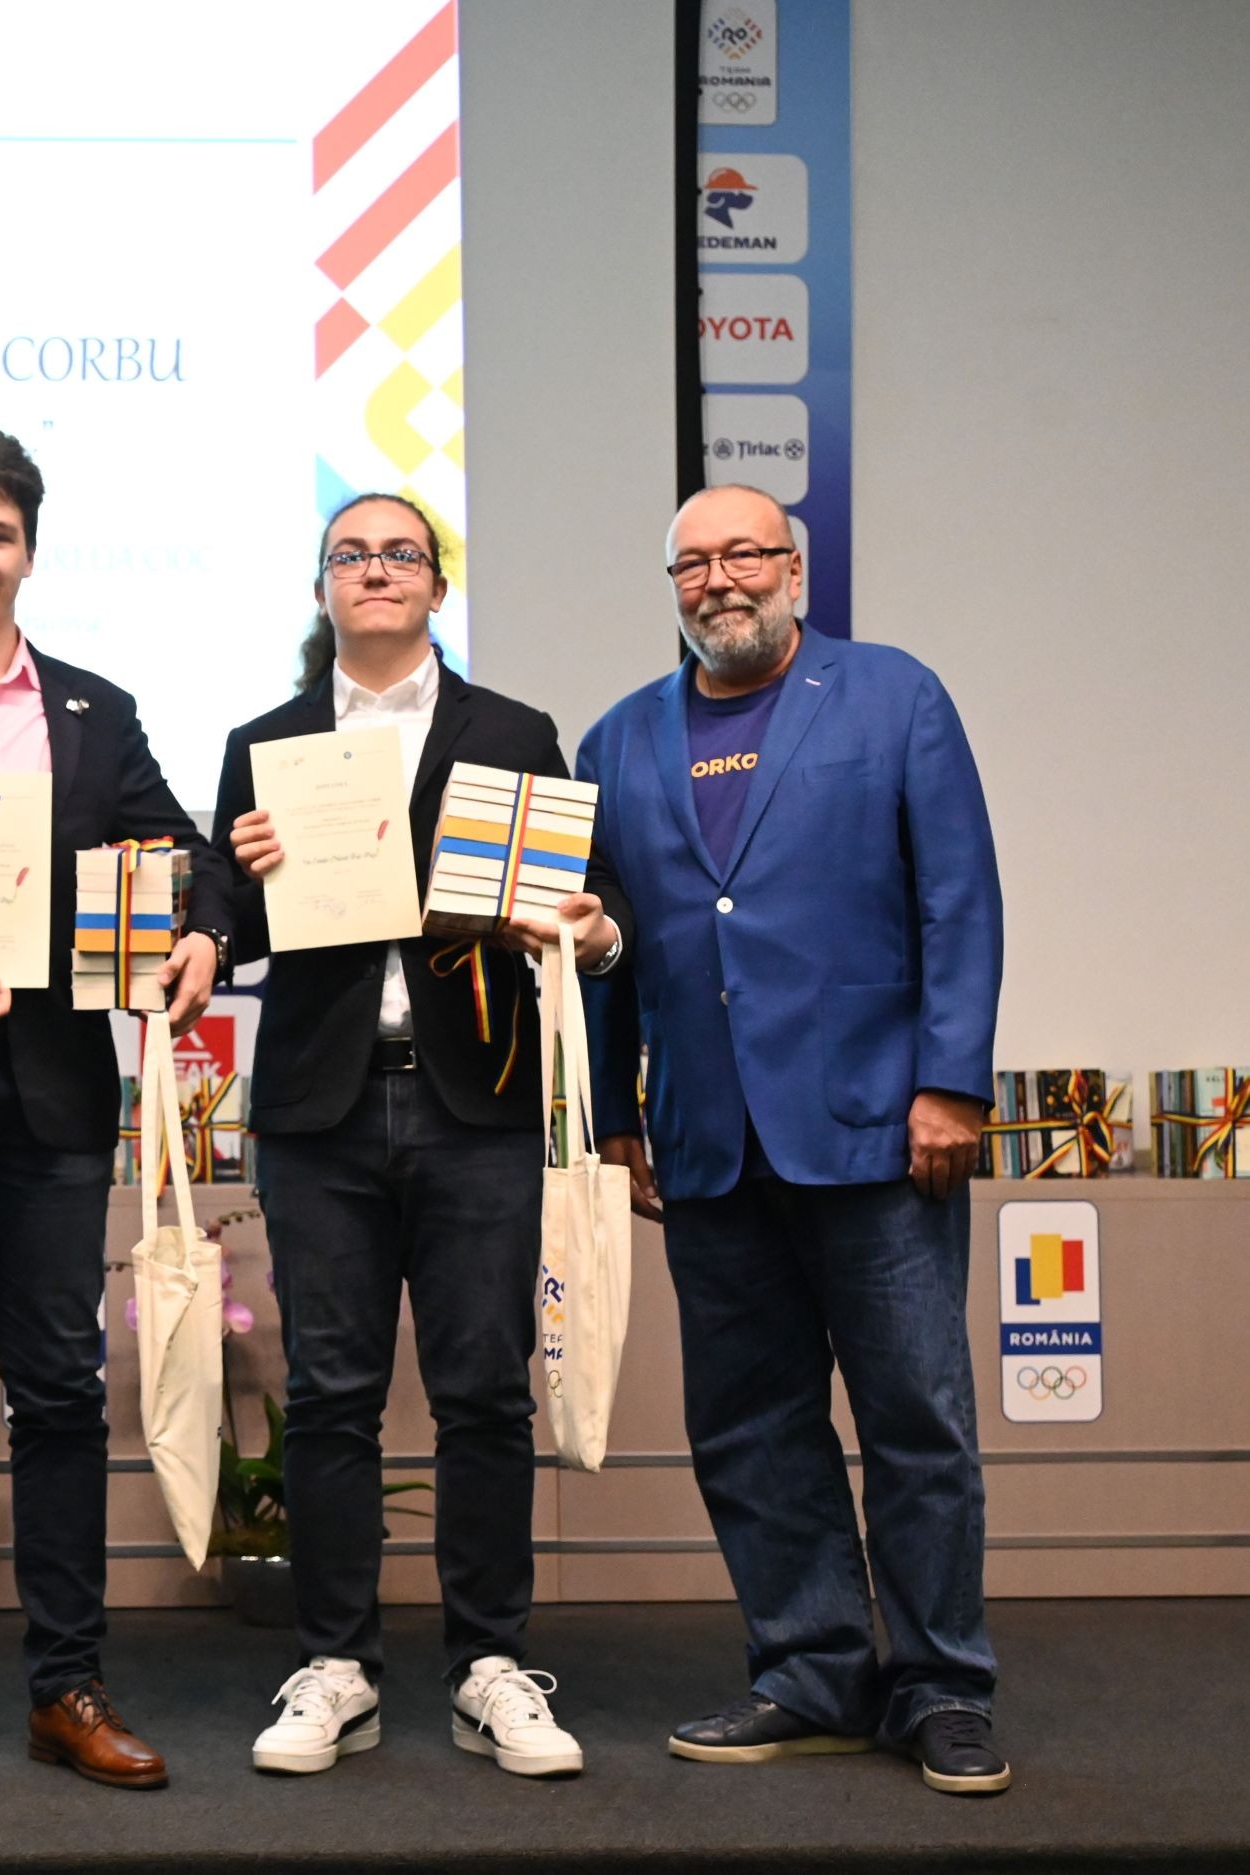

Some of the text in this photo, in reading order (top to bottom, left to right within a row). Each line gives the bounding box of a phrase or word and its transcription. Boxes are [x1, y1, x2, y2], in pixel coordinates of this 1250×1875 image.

[697, 236, 777, 249] EDEMAN
[1, 336, 185, 383] CORBU
[1009, 1329, 1093, 1346] ROMÂNIA
